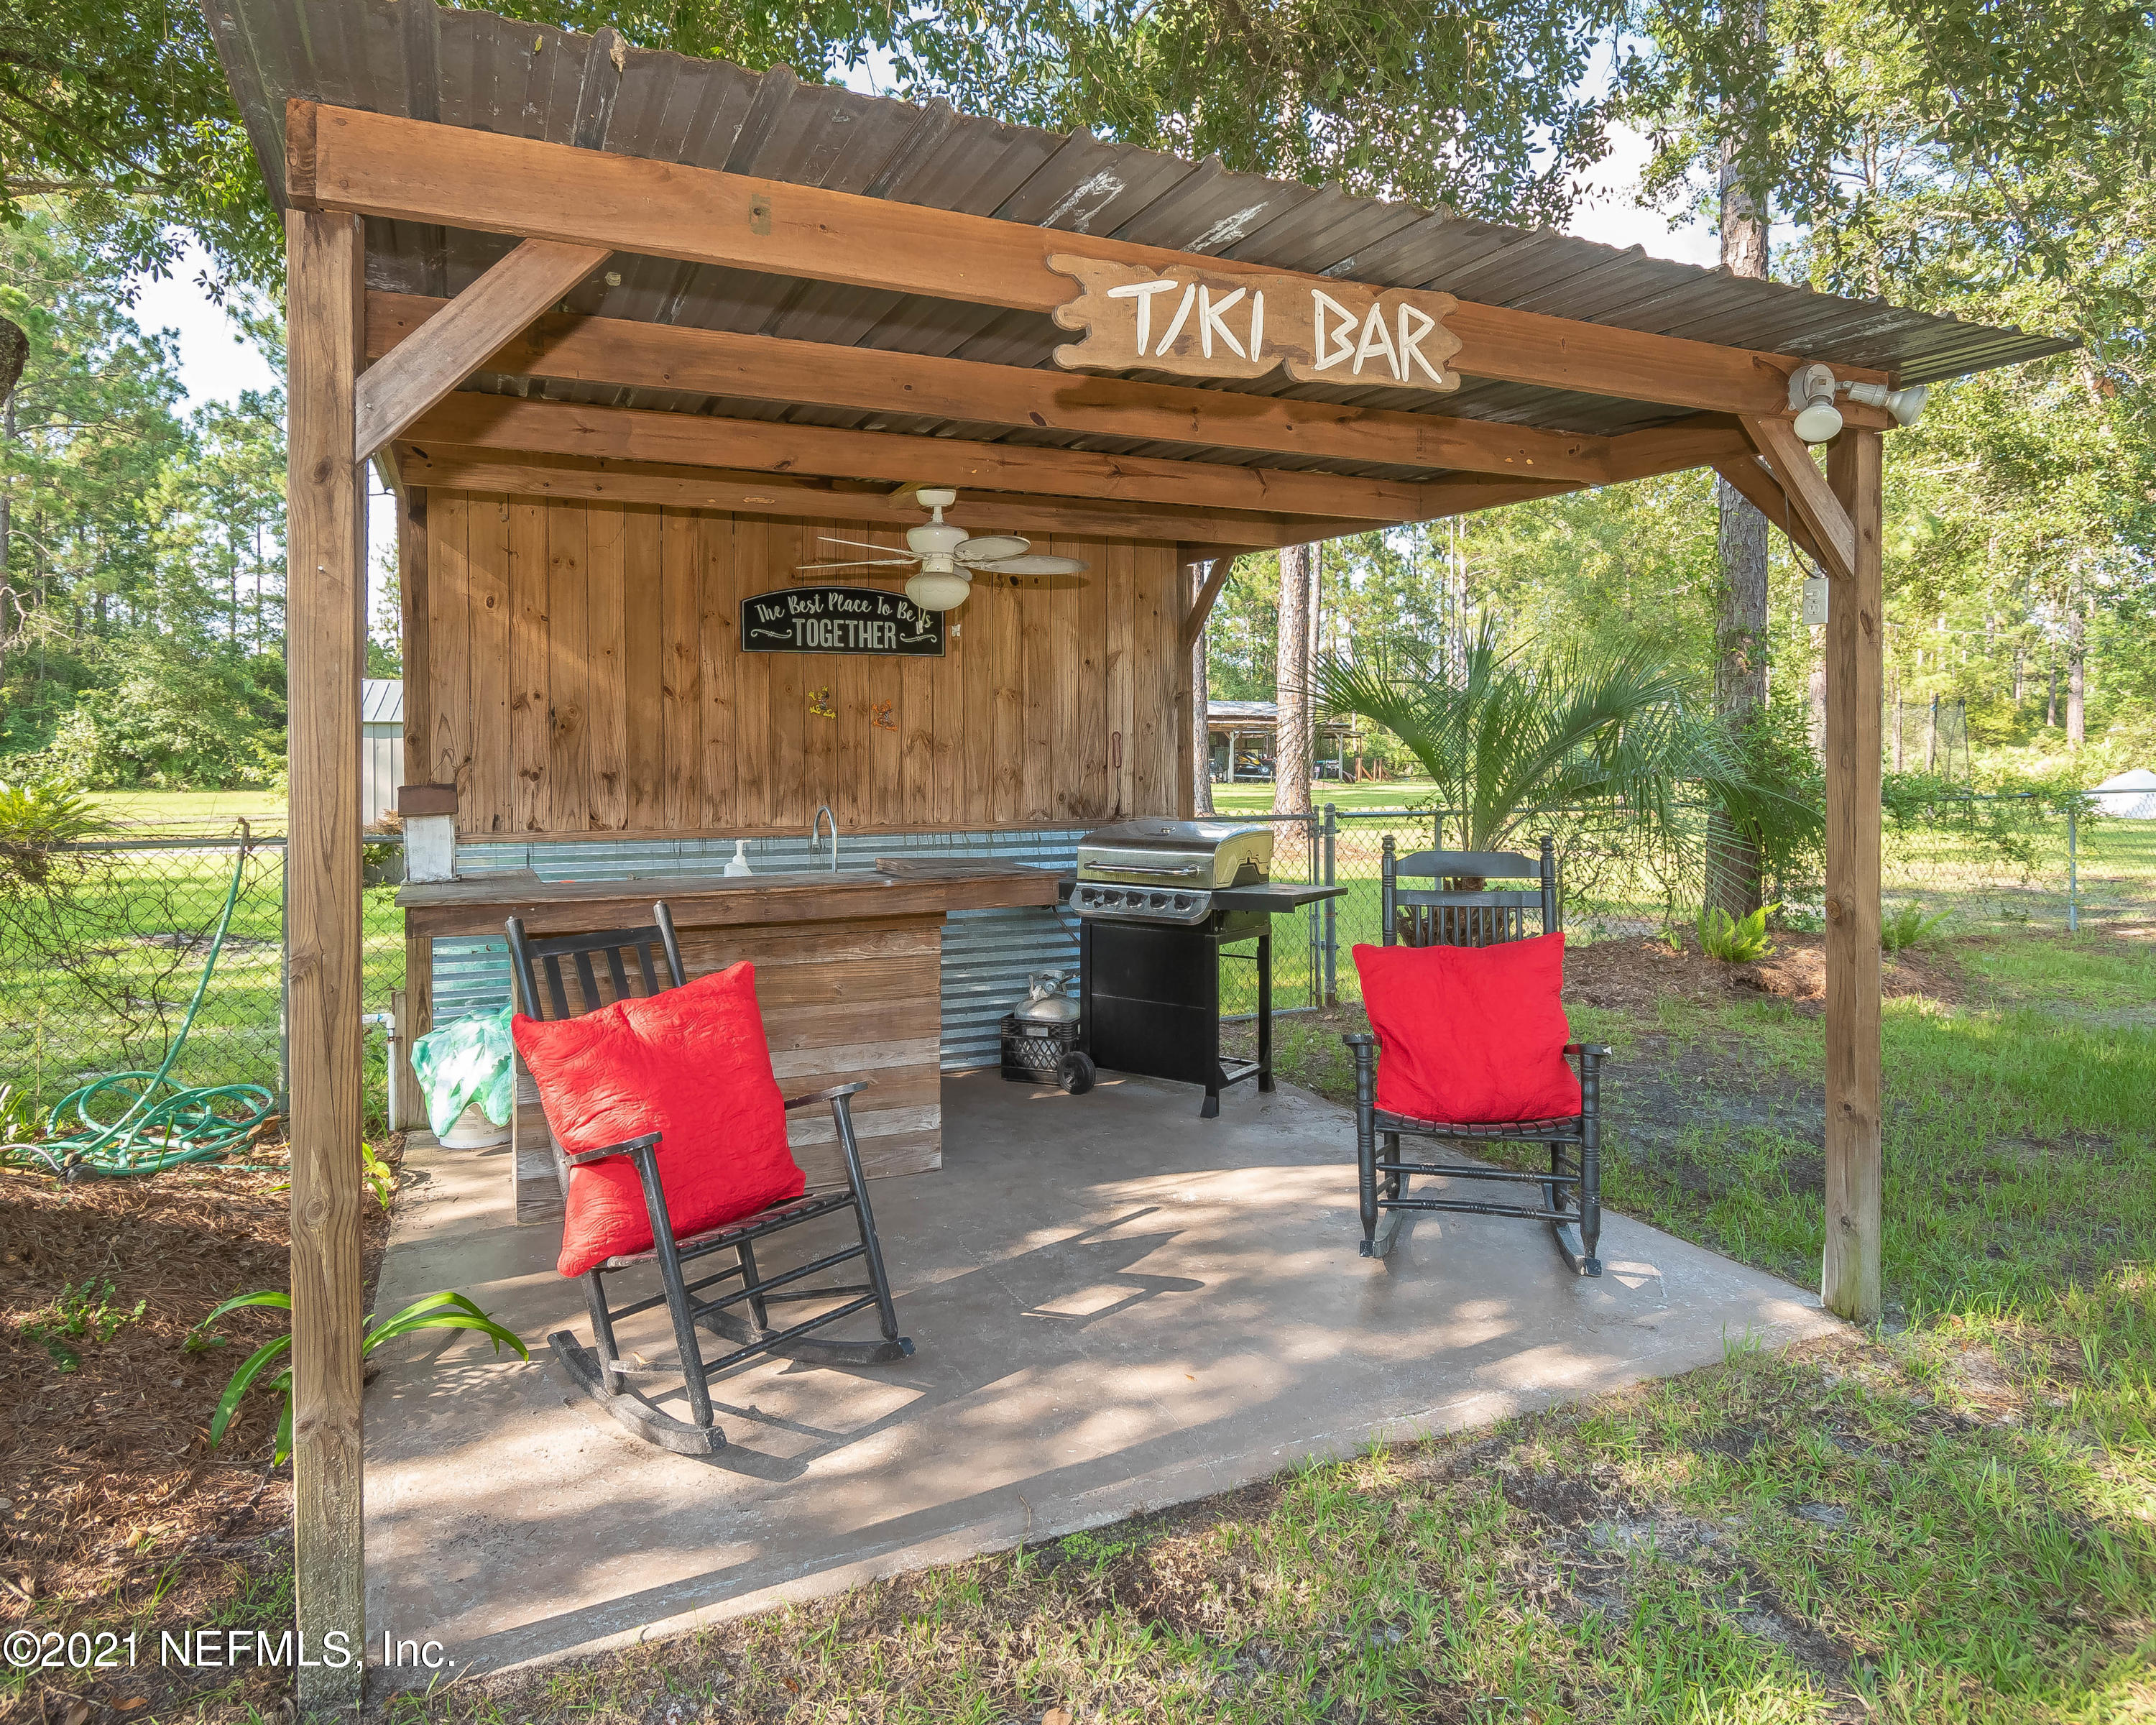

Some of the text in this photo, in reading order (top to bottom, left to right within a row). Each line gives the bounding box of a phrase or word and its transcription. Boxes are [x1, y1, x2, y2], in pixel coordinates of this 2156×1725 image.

[1107, 280, 1442, 384] TIKI BAR
[755, 602, 785, 622] The
[788, 594, 824, 615] Best
[829, 592, 872, 612] Place
[877, 596, 893, 615] To
[897, 600, 916, 622] Be
[792, 618, 897, 649] TOGETHER
